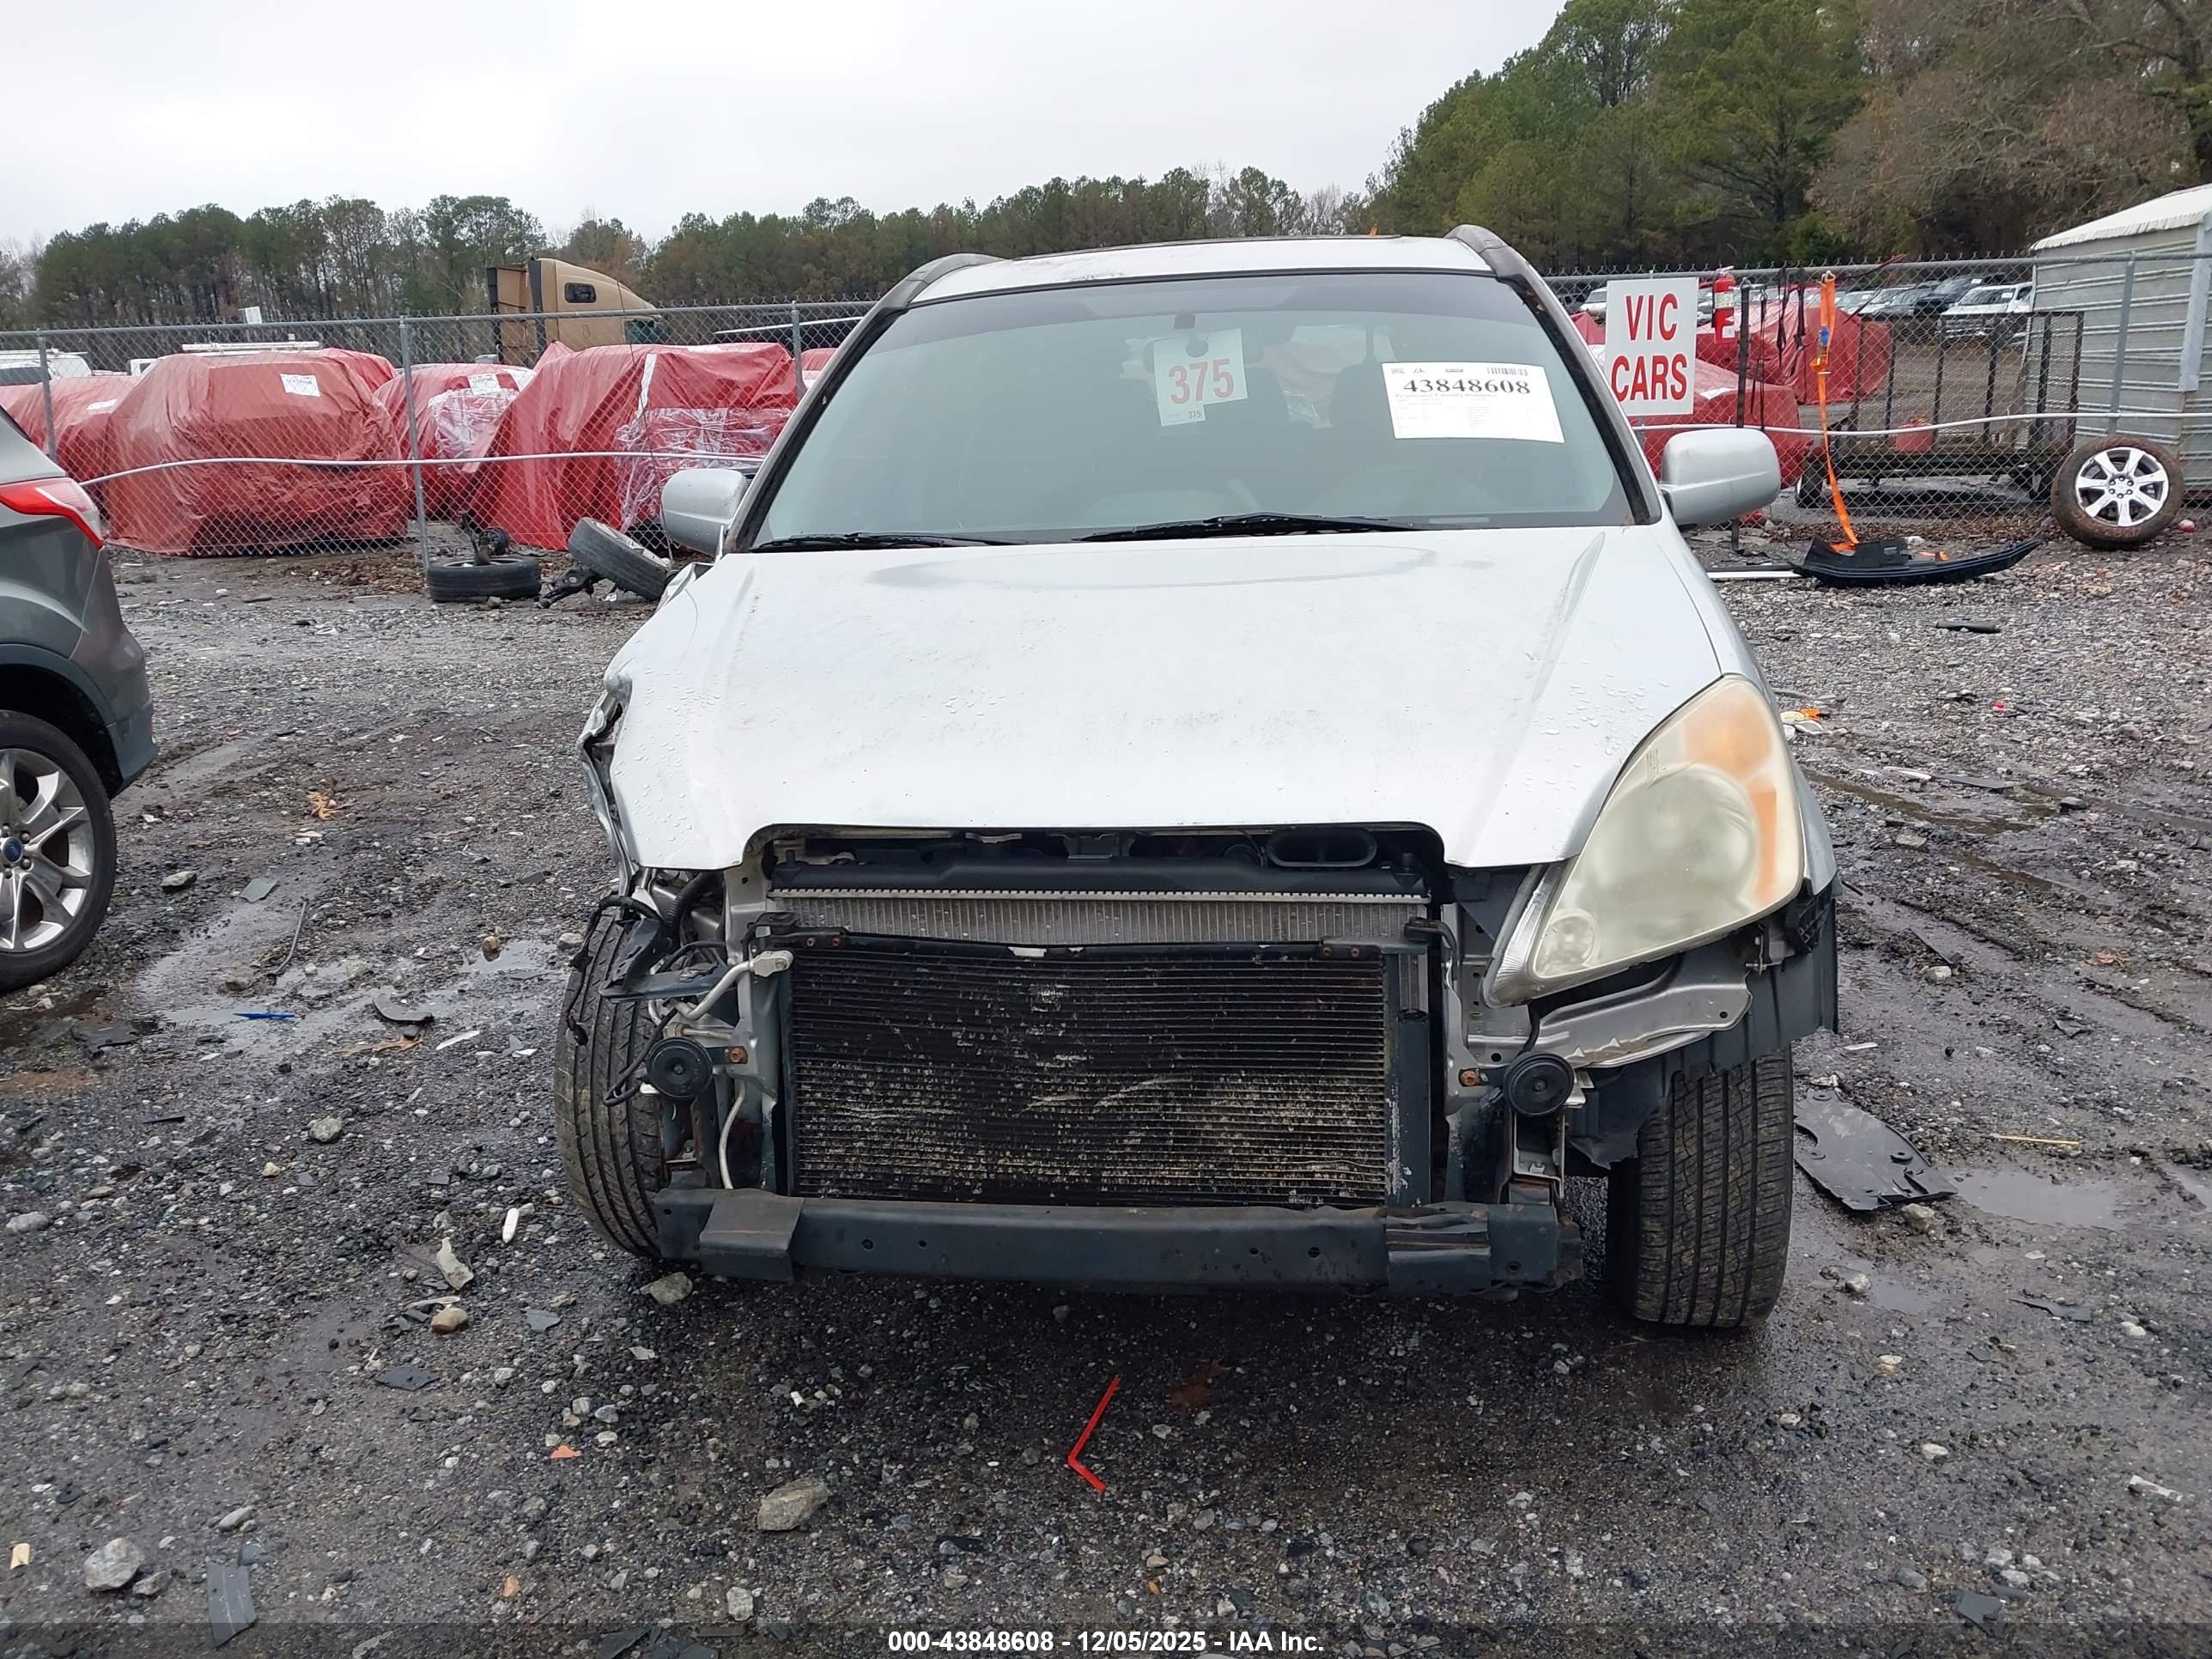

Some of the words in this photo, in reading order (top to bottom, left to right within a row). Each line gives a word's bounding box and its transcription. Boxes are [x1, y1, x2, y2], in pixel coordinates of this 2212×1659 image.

[1626, 293, 1678, 341] VIC
[1168, 358, 1235, 404] 375
[1404, 379, 1531, 395] 43848608
[1611, 353, 1687, 402] CARS
[1188, 410, 1202, 419] 375
